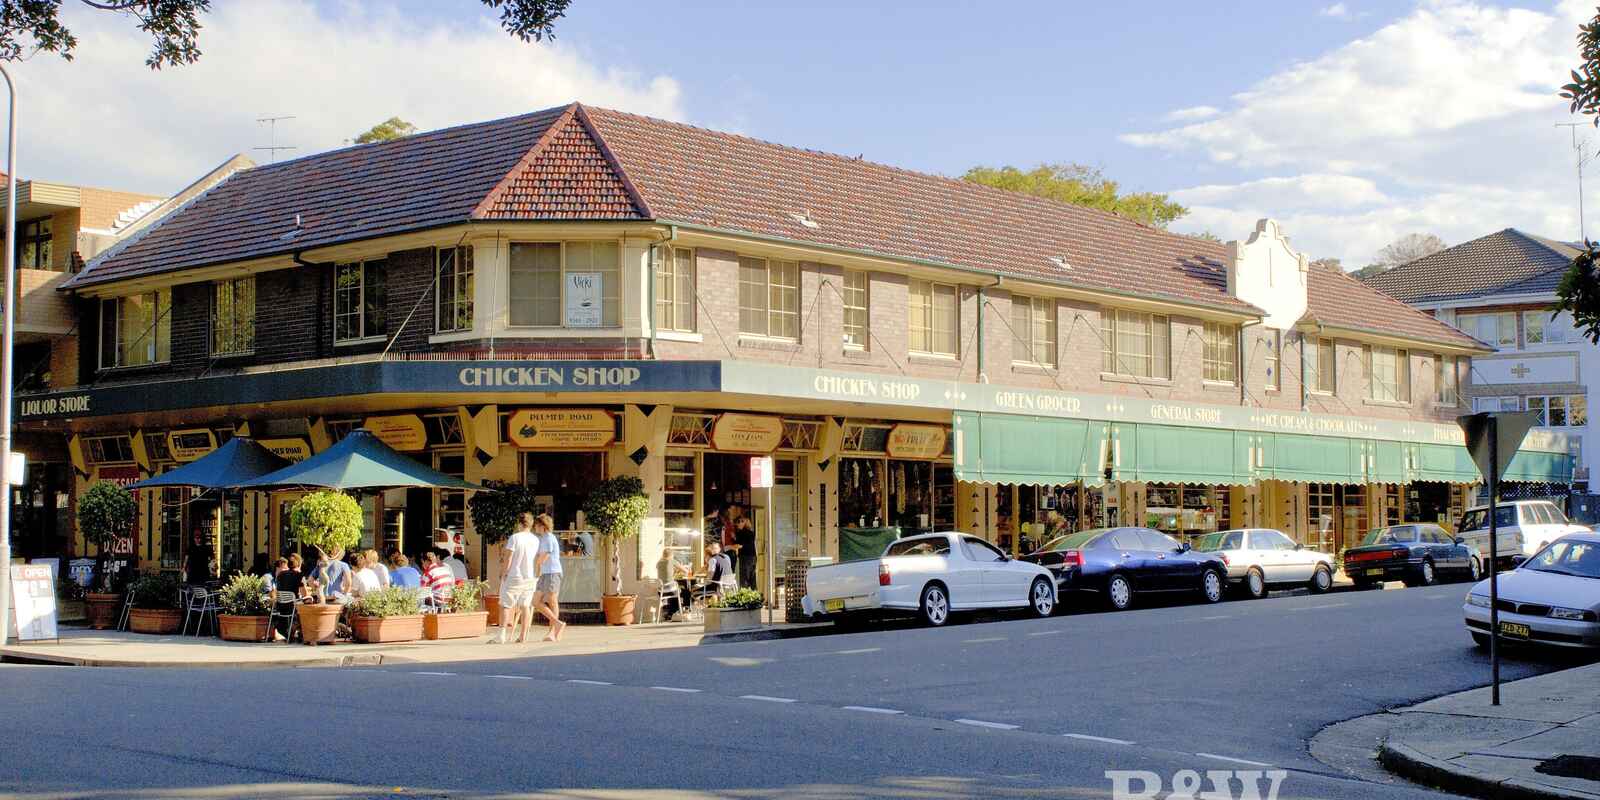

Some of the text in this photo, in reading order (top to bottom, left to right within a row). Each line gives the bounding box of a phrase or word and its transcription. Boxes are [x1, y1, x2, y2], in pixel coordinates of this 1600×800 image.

[459, 367, 641, 386] CHICKEN SHOP
[814, 375, 920, 400] CHICKEN SHOP
[21, 396, 90, 416] LIQUOR STORE
[995, 391, 1081, 413] GREEN GROCER
[529, 413, 565, 421] PLUMER
[1150, 404, 1222, 424] GENERAL STORE
[1265, 414, 1279, 426] ICE
[121, 478, 139, 489] SALE
